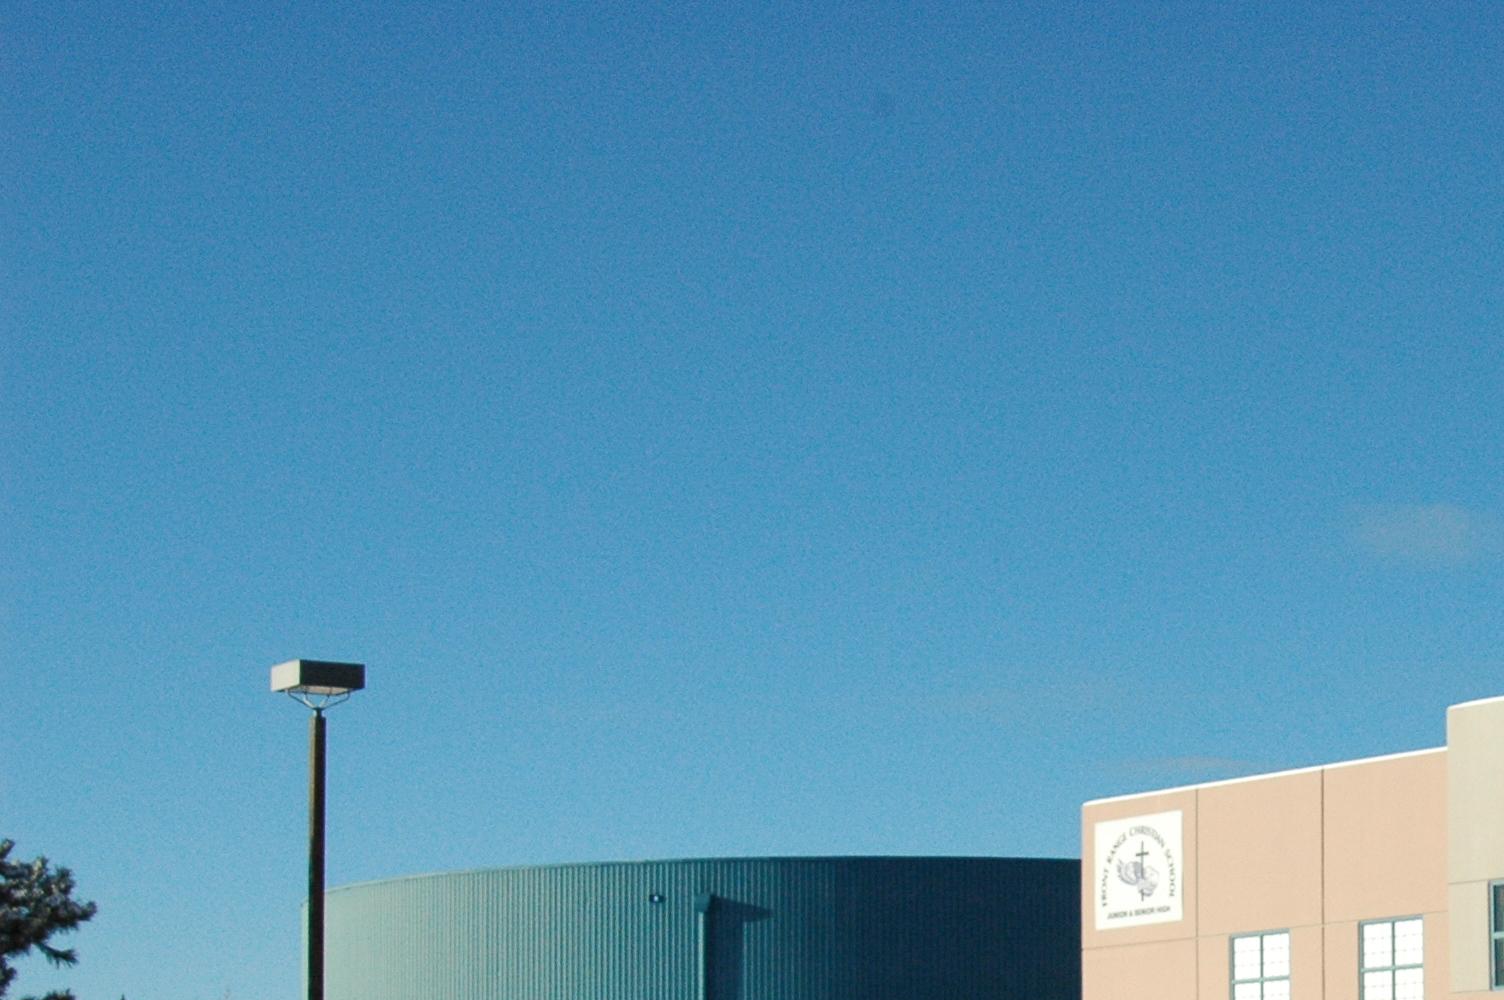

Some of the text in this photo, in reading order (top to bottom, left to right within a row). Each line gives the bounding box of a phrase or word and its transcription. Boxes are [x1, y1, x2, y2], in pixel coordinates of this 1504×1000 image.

[1101, 825, 1176, 907] FRONT RANGE CHRISTIAN SCHOOL
[1107, 910, 1128, 920] JUNIOR
[1134, 906, 1155, 917] SENIOR
